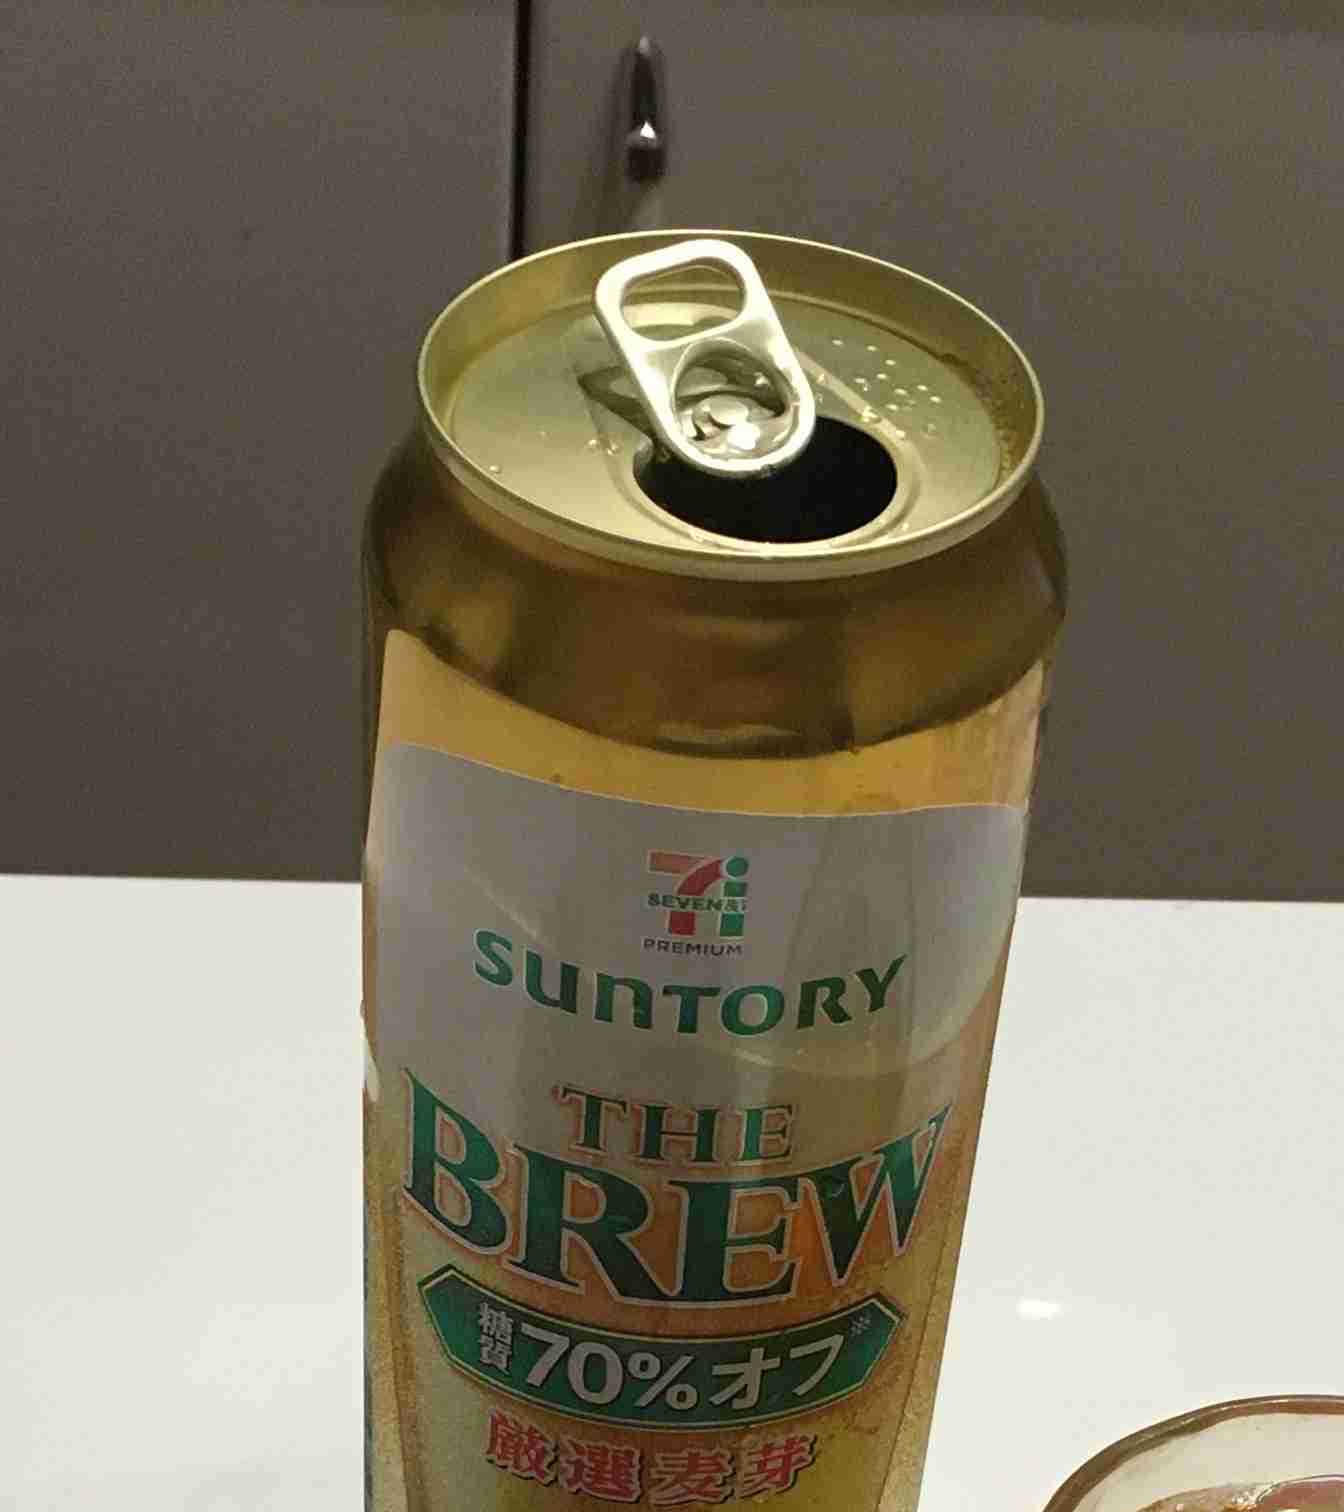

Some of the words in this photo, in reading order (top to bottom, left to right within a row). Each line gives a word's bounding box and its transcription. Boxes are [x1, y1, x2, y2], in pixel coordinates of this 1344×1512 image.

[473, 929, 907, 1037] SUNTORY
[642, 938, 743, 957] PREMIUM
[558, 1083, 793, 1163] THE
[402, 1066, 953, 1306] BREW
[486, 1409, 818, 1505] 厳選麦芽
